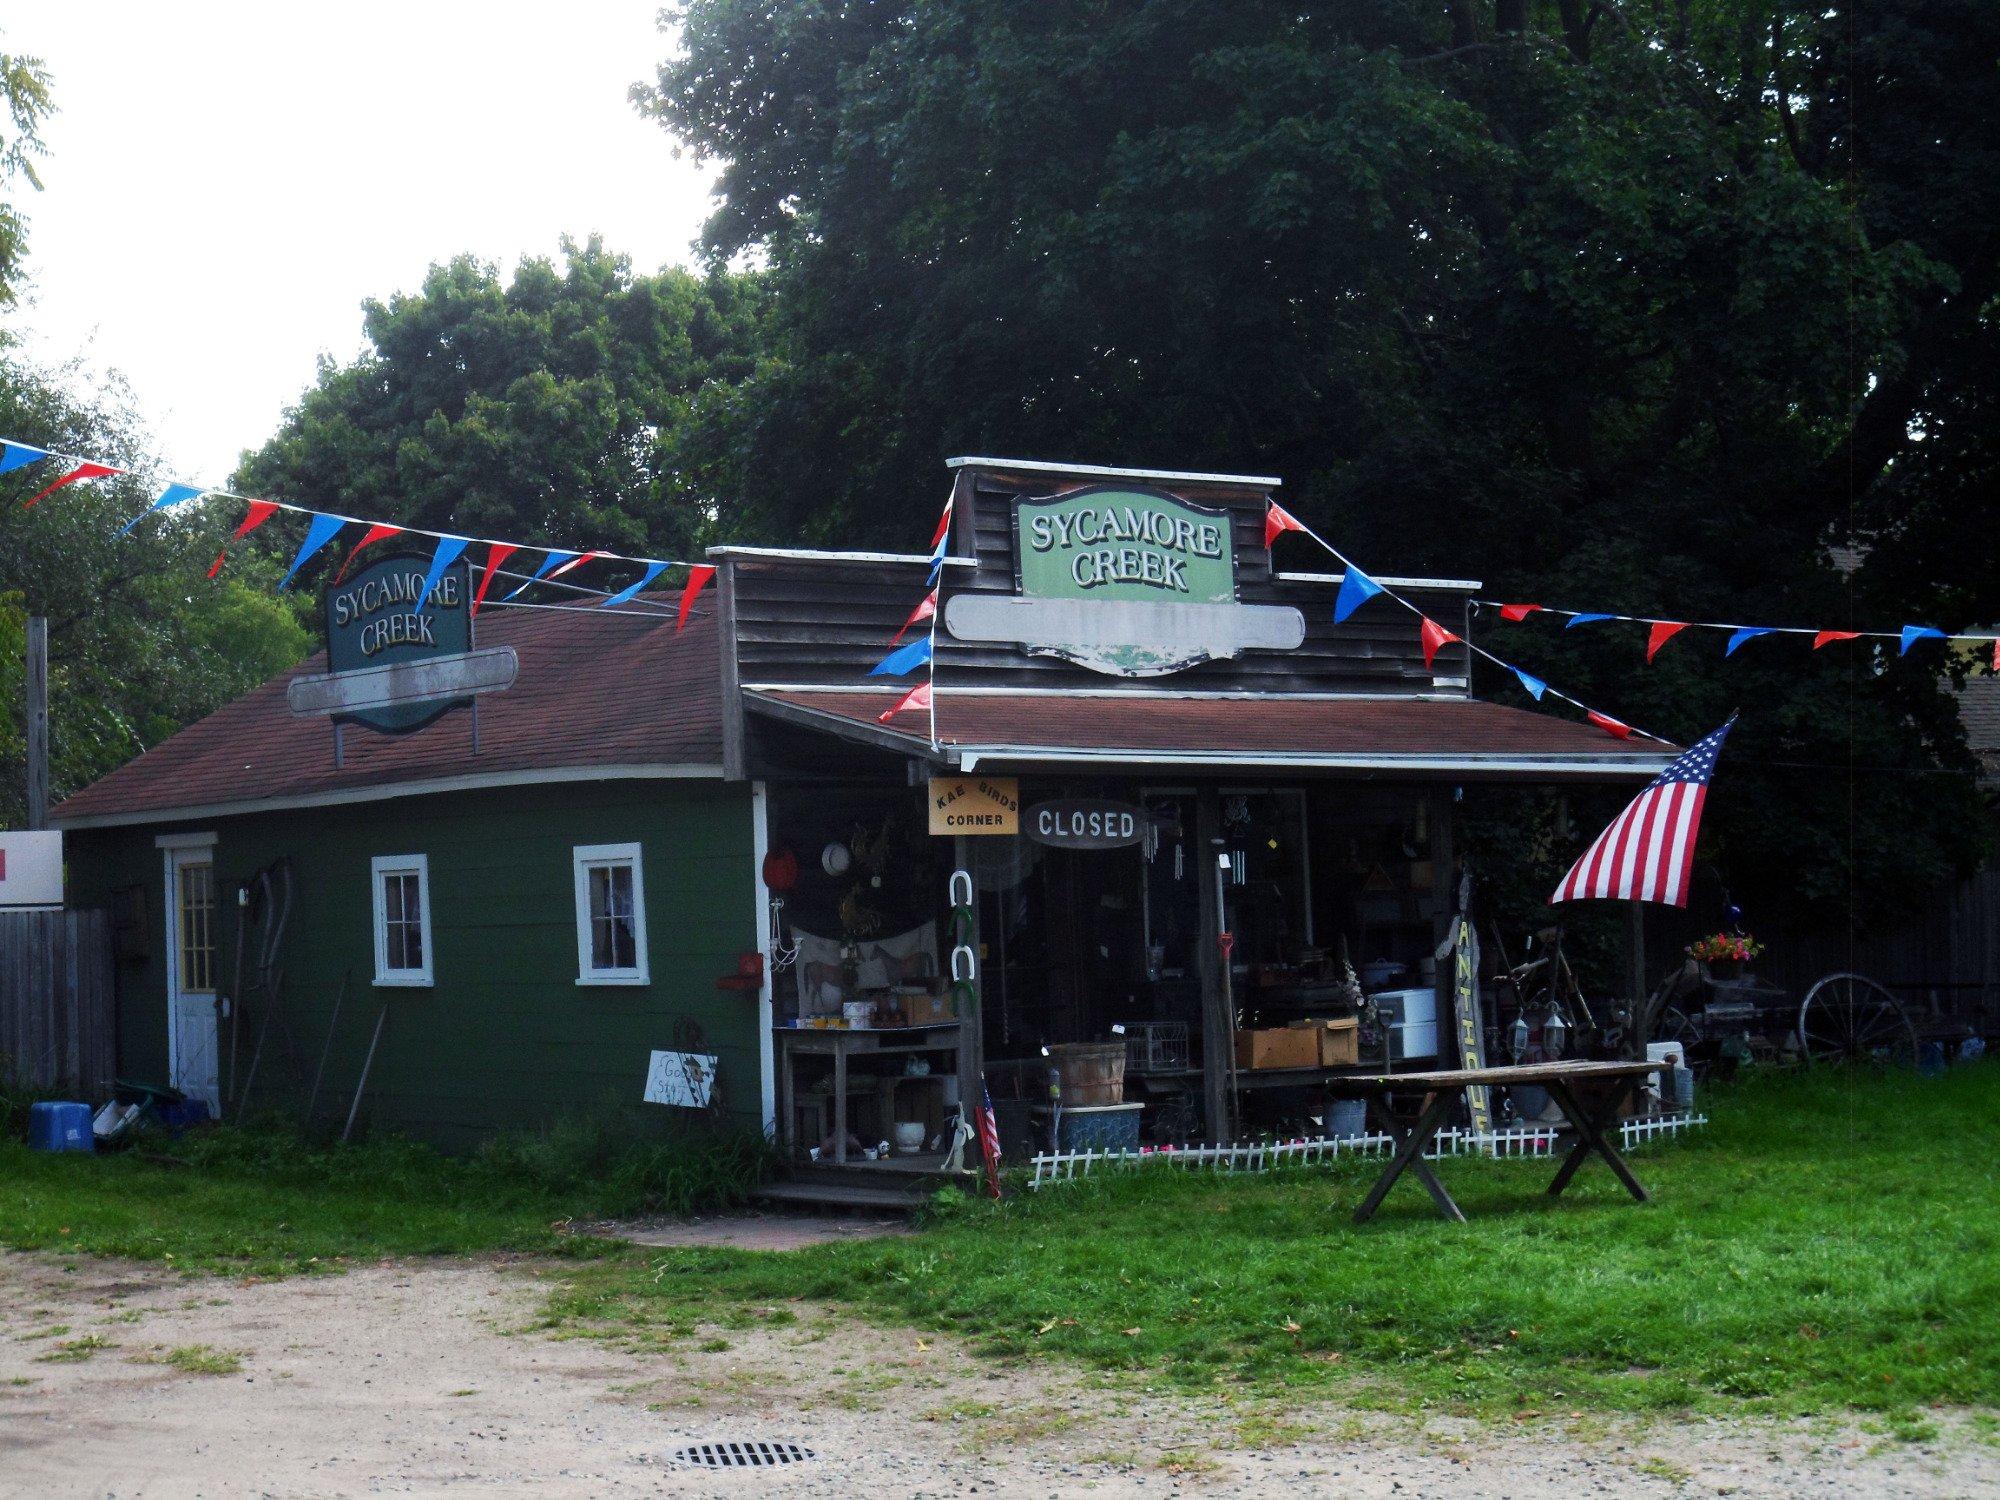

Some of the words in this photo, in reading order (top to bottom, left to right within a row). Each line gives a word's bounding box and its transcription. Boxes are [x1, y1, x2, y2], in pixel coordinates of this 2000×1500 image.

[1031, 506, 1222, 557] SYCAMORE
[1071, 548, 1188, 592] CREEK
[360, 613, 436, 655] CREEK
[936, 784, 966, 810] KAE
[979, 781, 1018, 812] BIRDS
[946, 814, 1003, 826] CORNER
[1038, 810, 1134, 838] CLOSED
